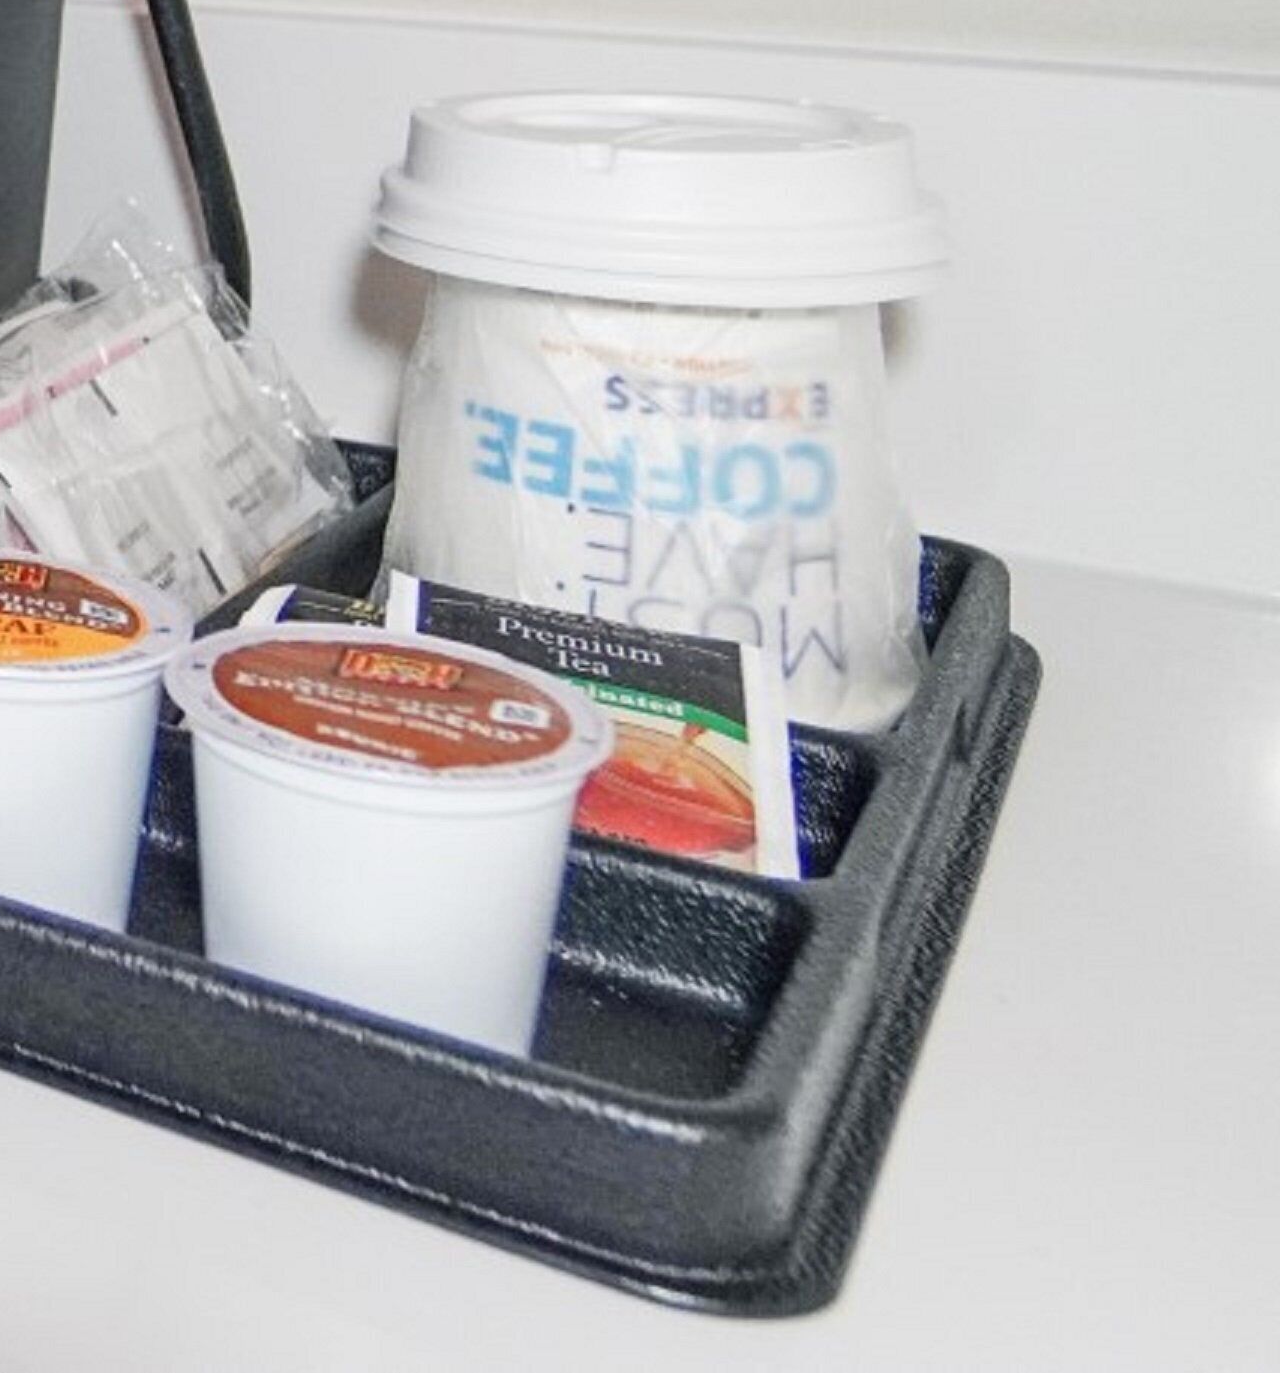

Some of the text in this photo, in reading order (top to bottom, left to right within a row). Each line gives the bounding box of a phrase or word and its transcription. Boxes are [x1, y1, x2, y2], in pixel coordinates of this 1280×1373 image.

[604, 374, 830, 421] EXPRESS
[497, 616, 664, 668] Premium
[552, 645, 611, 678] Tea
